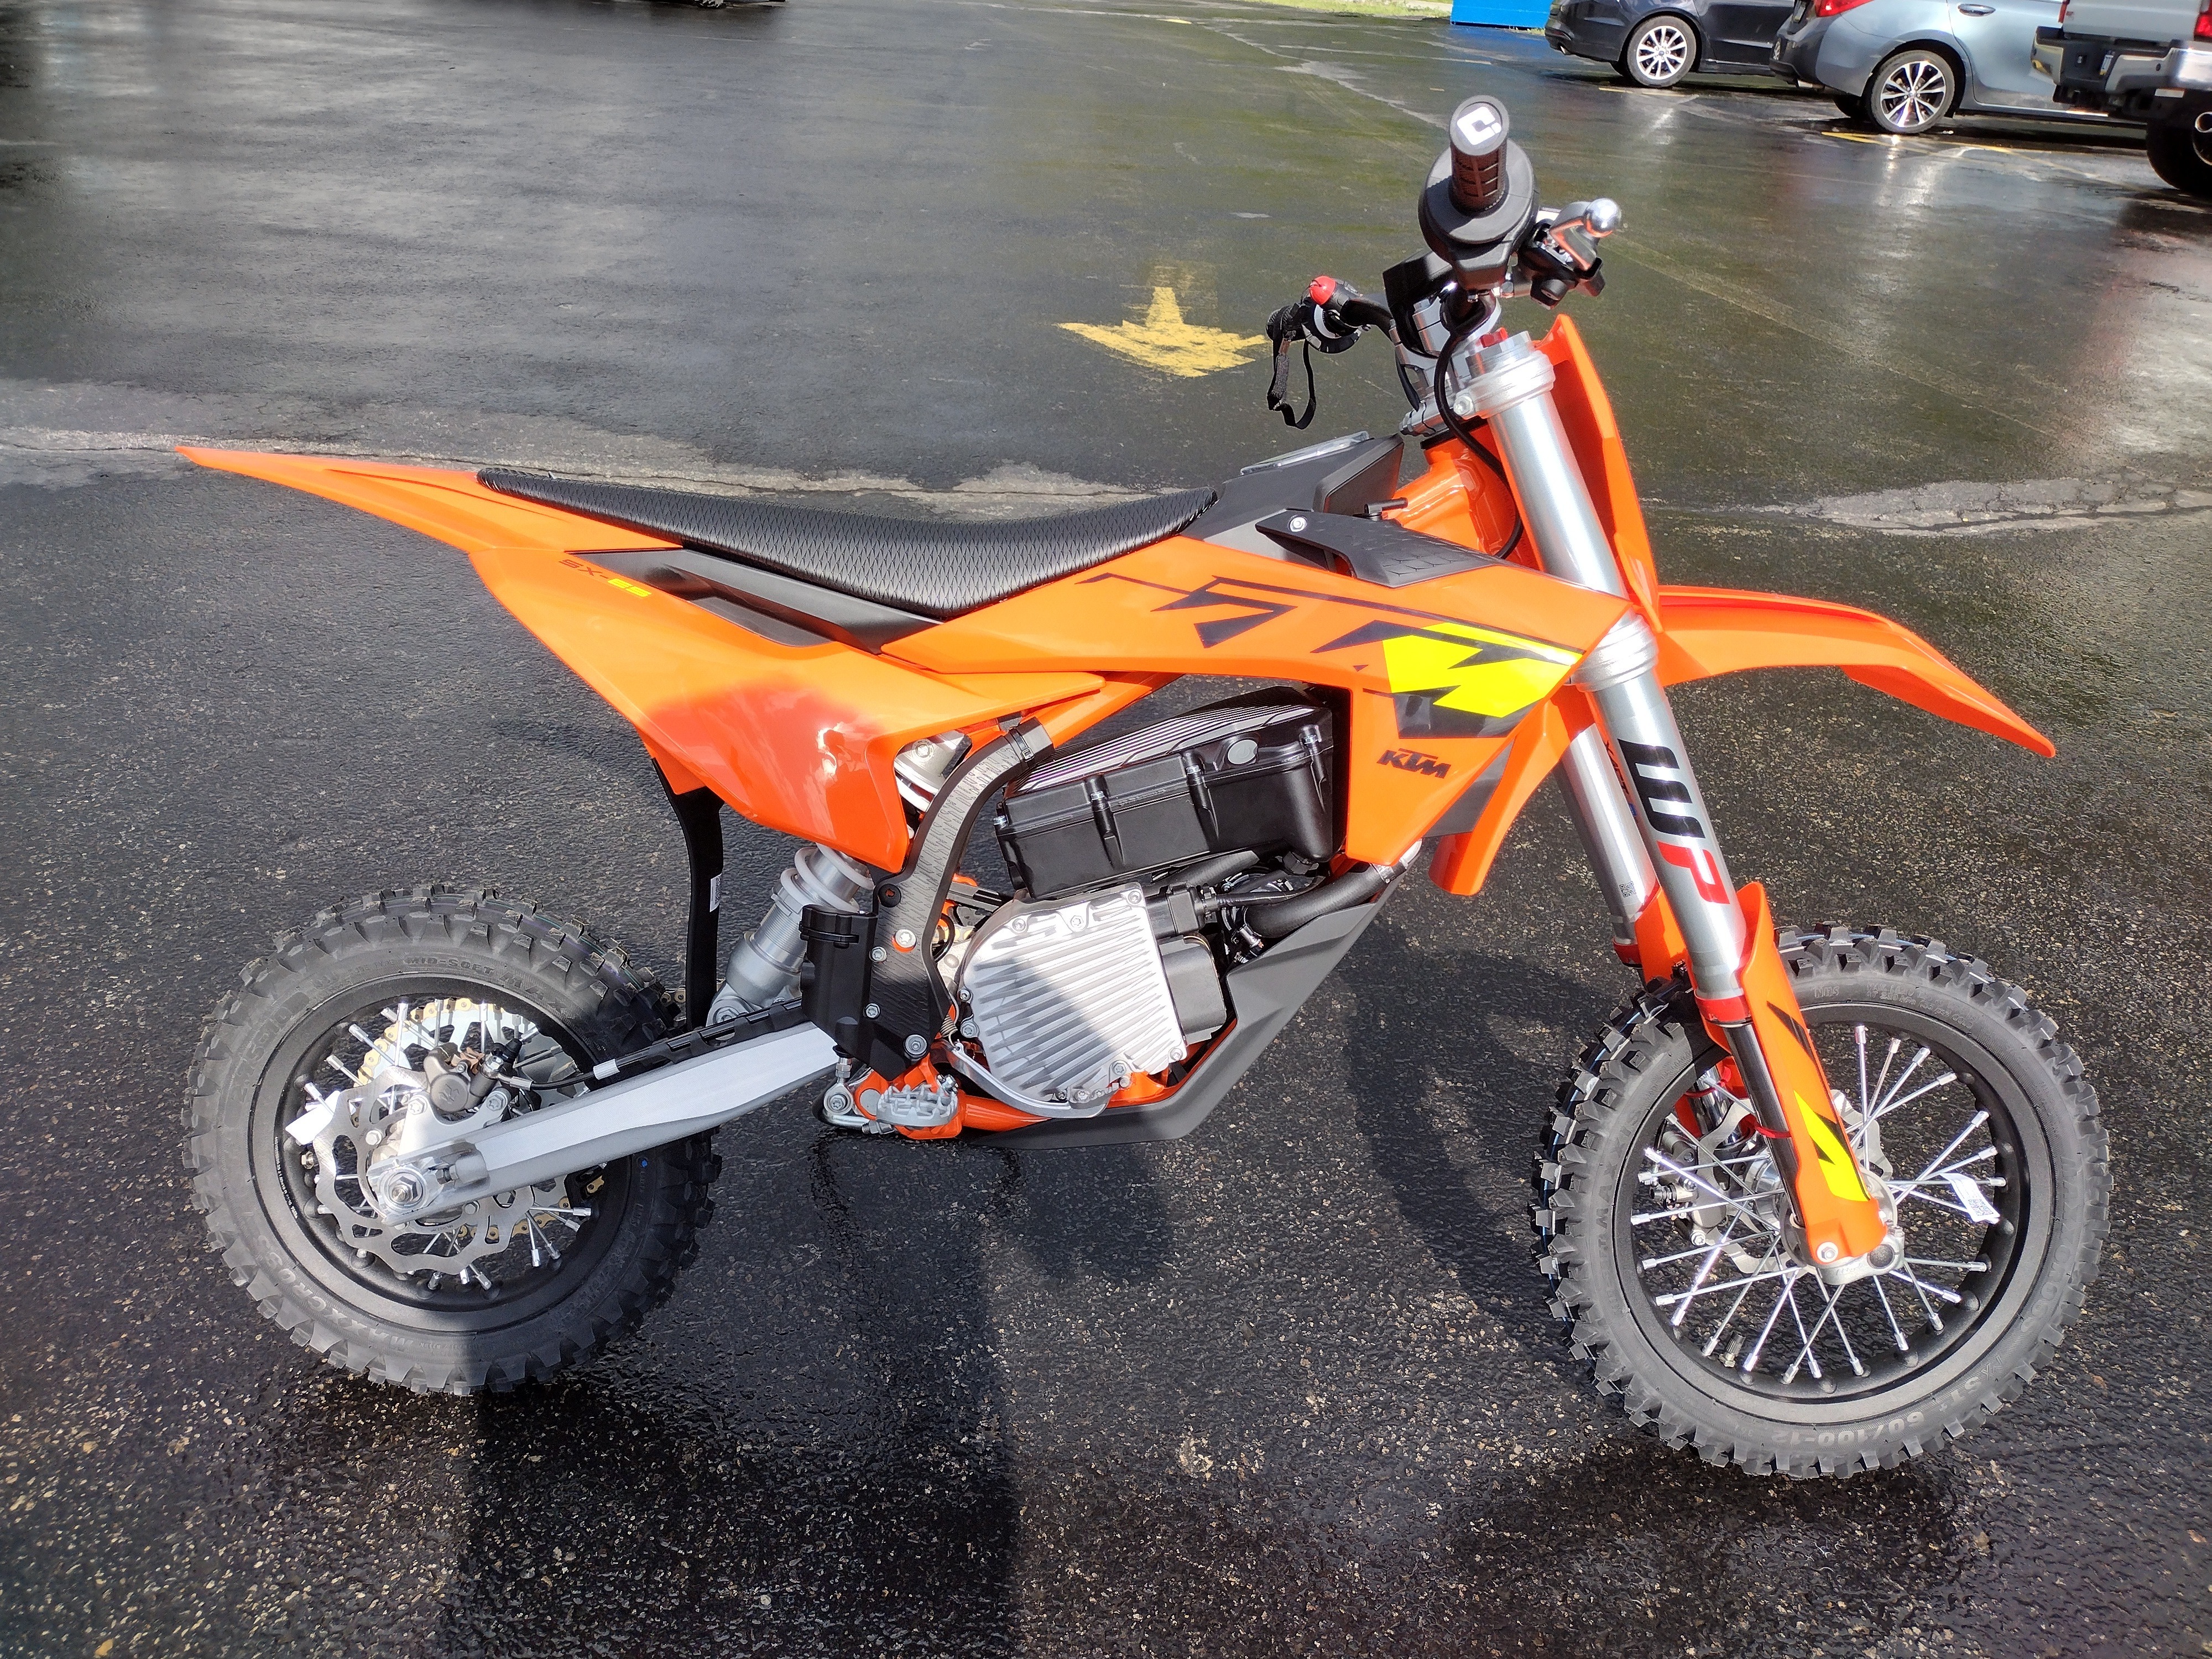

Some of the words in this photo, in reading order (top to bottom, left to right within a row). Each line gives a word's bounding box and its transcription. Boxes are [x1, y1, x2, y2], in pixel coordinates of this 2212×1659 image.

[1377, 748, 1452, 779] KTM
[1618, 738, 1730, 904] WP
[403, 957, 494, 975] MID-SOFT
[1812, 985, 1839, 998] NHS
[250, 1233, 414, 1350] MAXXCROSS
[1770, 1410, 1927, 1446] 60/100-12
